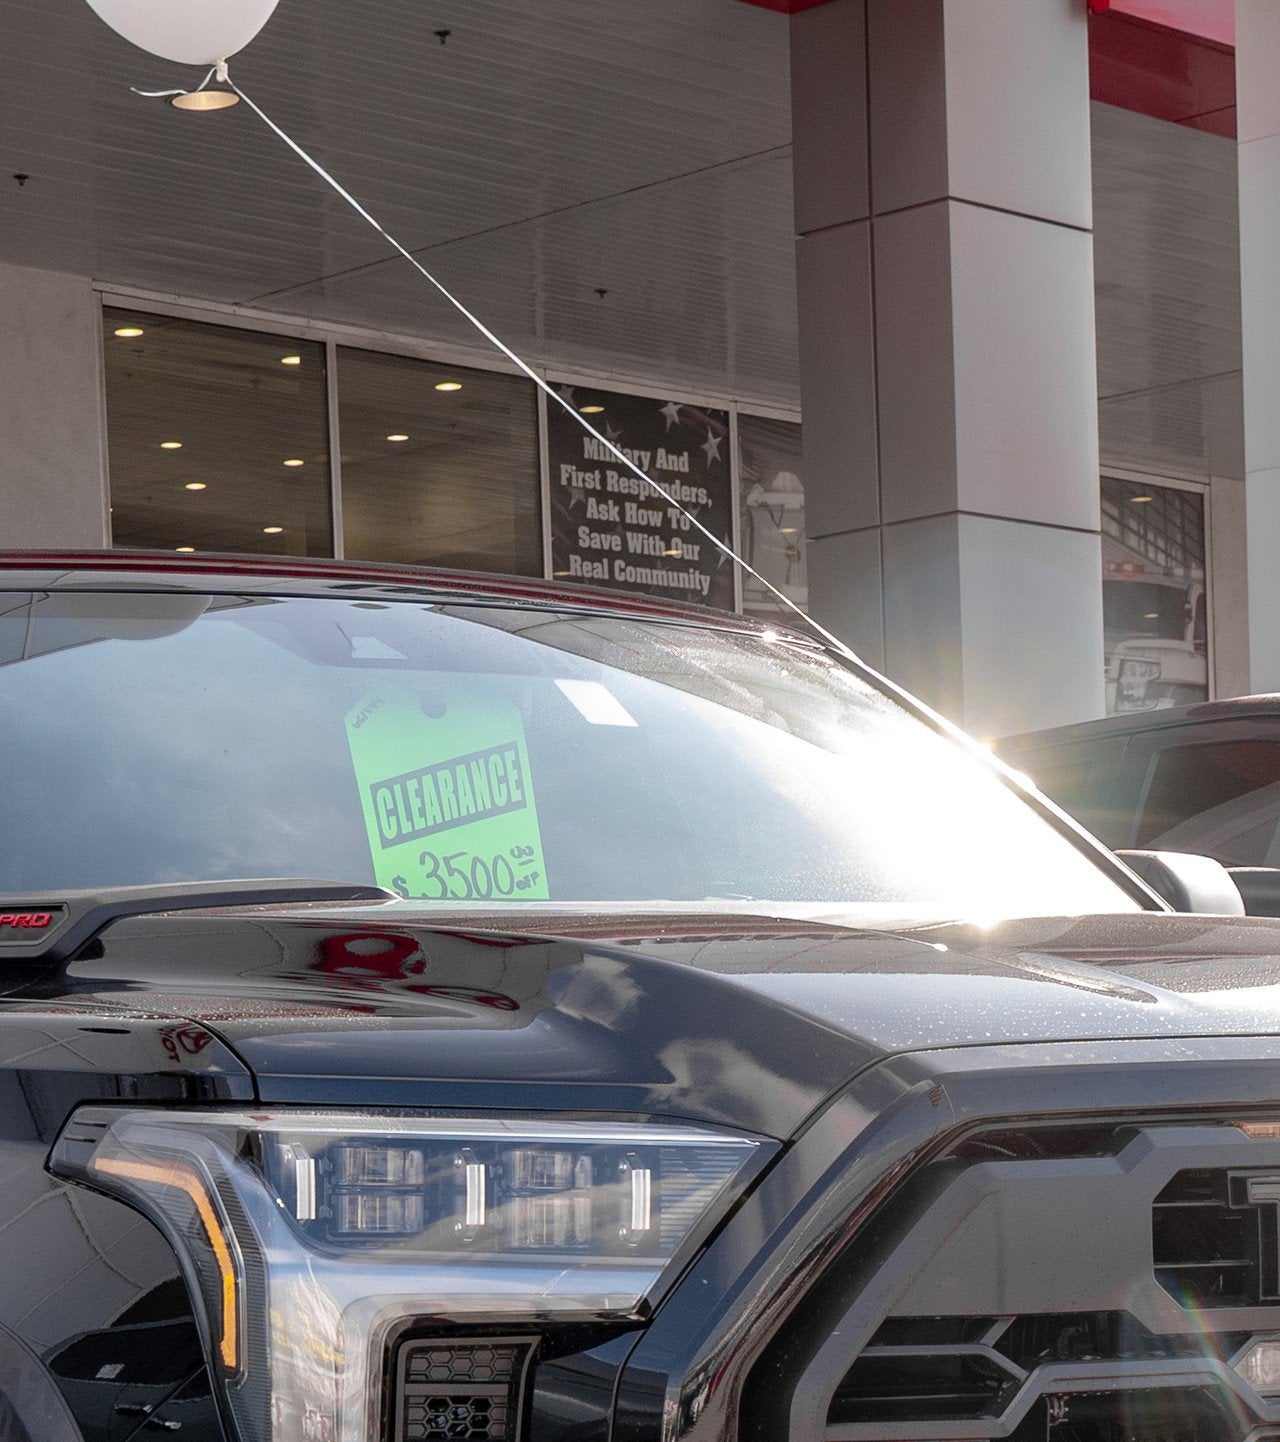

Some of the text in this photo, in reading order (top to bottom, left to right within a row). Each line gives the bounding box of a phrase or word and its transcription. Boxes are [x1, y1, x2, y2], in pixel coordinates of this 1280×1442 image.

[560, 464, 601, 490] First
[656, 447, 690, 473] And
[586, 497, 691, 531] Ask How To
[577, 525, 701, 561] Save With Our
[569, 554, 711, 596] Real Community
[375, 750, 522, 840] CLEARANCE
